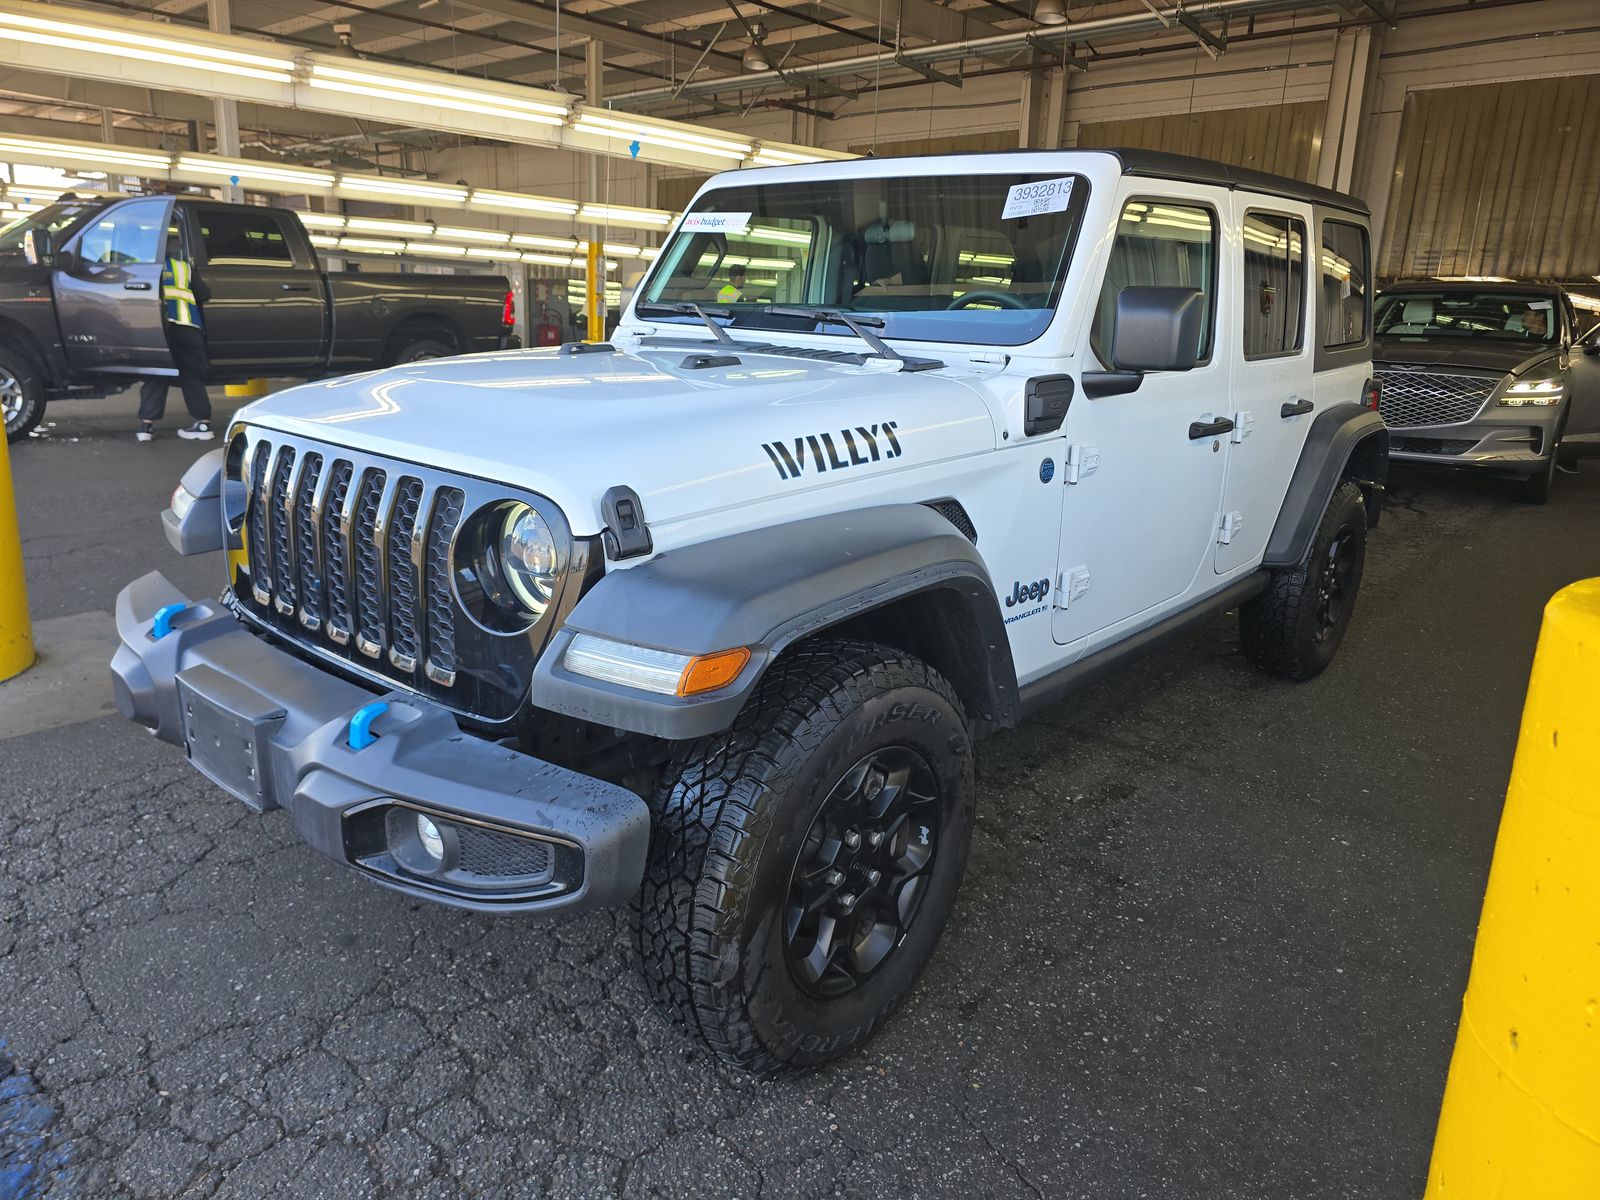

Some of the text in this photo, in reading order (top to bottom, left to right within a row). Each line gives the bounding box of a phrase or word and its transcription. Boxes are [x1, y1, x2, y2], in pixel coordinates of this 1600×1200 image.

[1014, 181, 1073, 201] 3932813
[700, 217, 726, 228] budget
[761, 421, 902, 480] WILLYS
[1005, 577, 1050, 607] Jeep
[1003, 607, 1041, 625] WRANGLER
